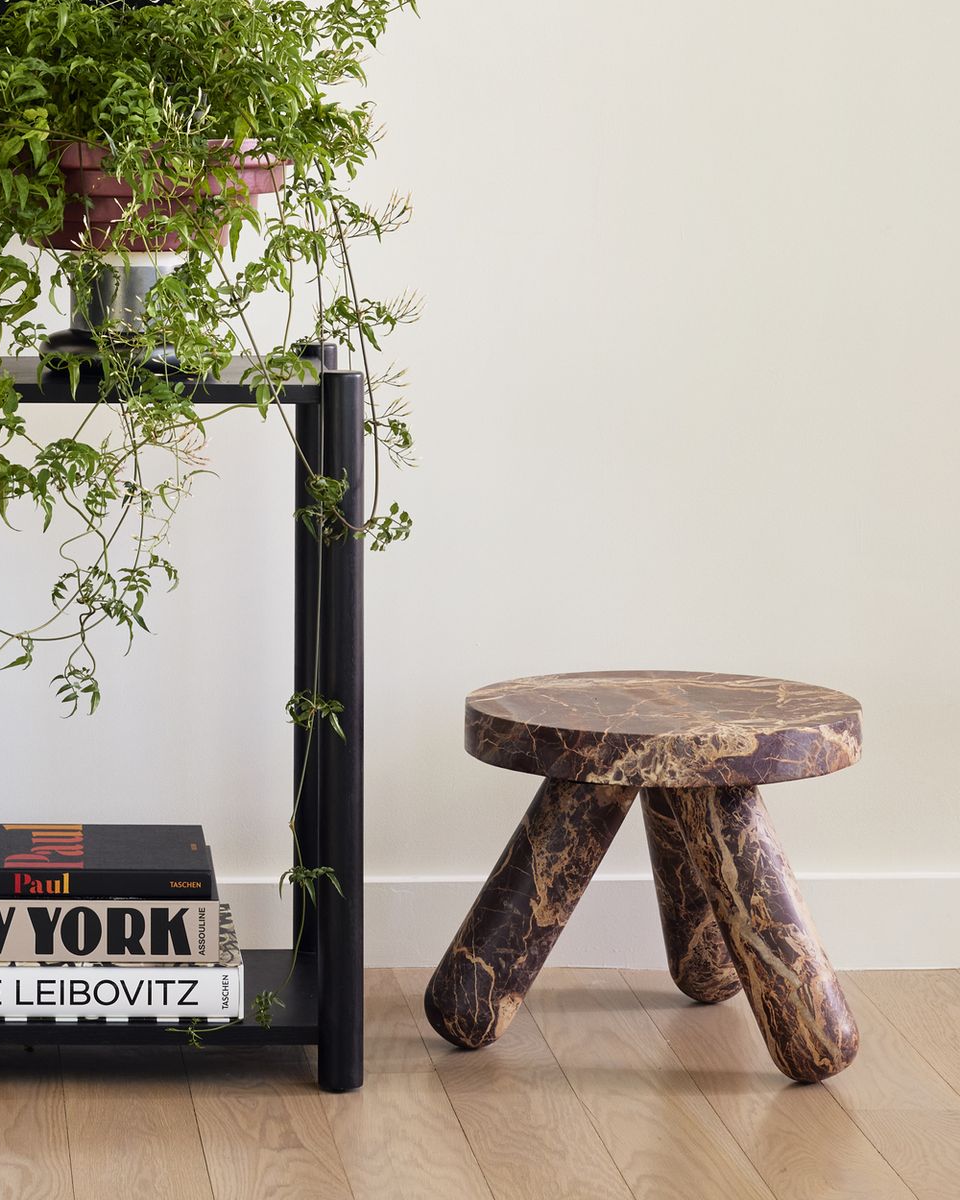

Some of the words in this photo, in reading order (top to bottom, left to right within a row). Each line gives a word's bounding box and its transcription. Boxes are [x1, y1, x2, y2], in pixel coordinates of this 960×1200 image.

[13, 872, 70, 894] Paul
[28, 906, 192, 956] YORK
[198, 907, 206, 956] ASSOULINE
[15, 980, 199, 1006] LEIBOVITZ
[221, 974, 229, 1010] TASCHEN
